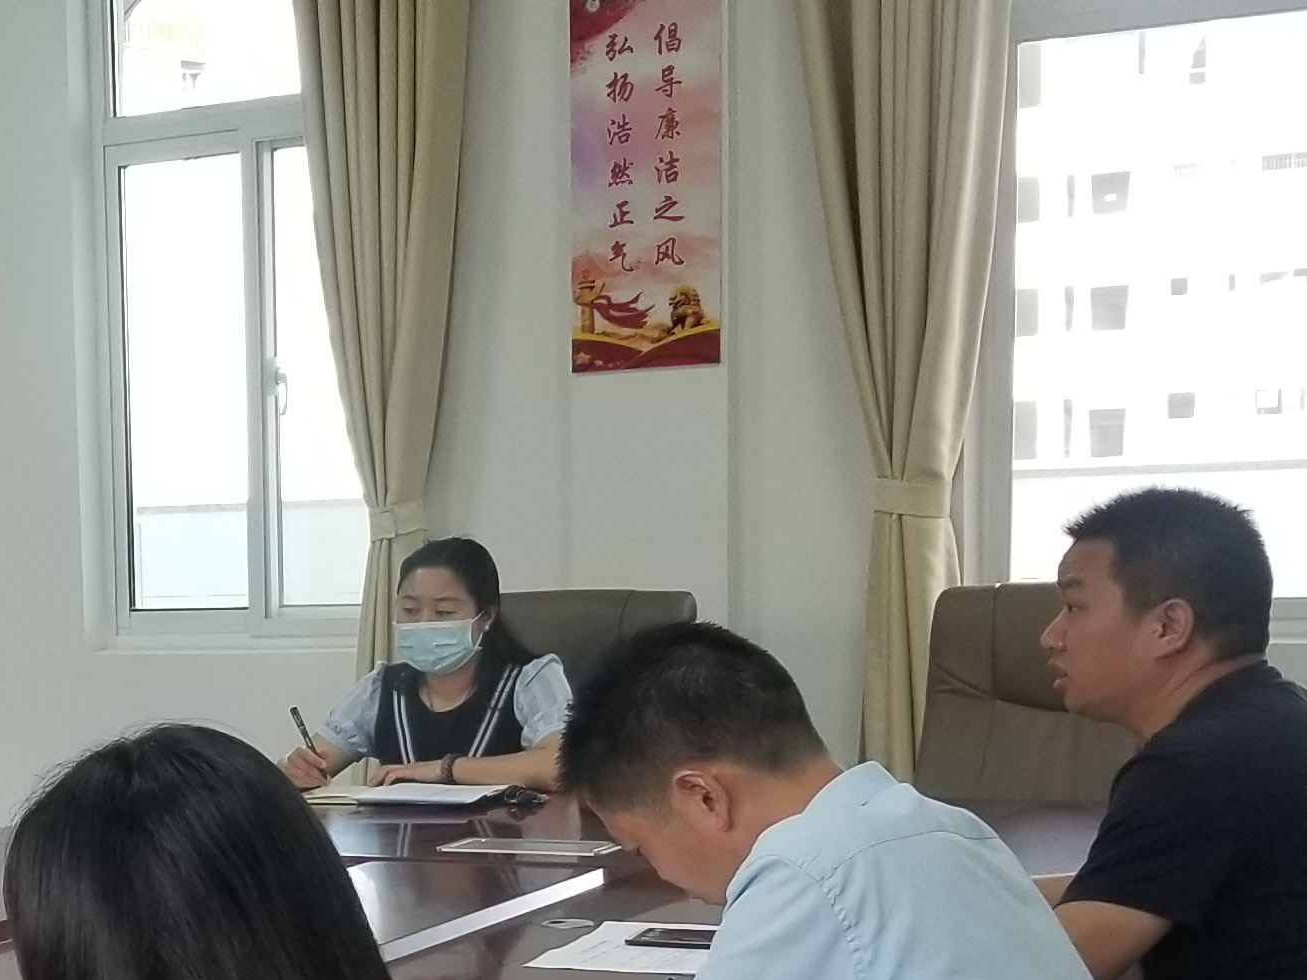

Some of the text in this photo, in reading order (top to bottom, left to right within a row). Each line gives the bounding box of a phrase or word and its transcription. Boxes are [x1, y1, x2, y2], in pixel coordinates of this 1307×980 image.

[605, 33, 635, 273] 弘扬浩然正气
[653, 22, 685, 266] 倡导廉洁之风
